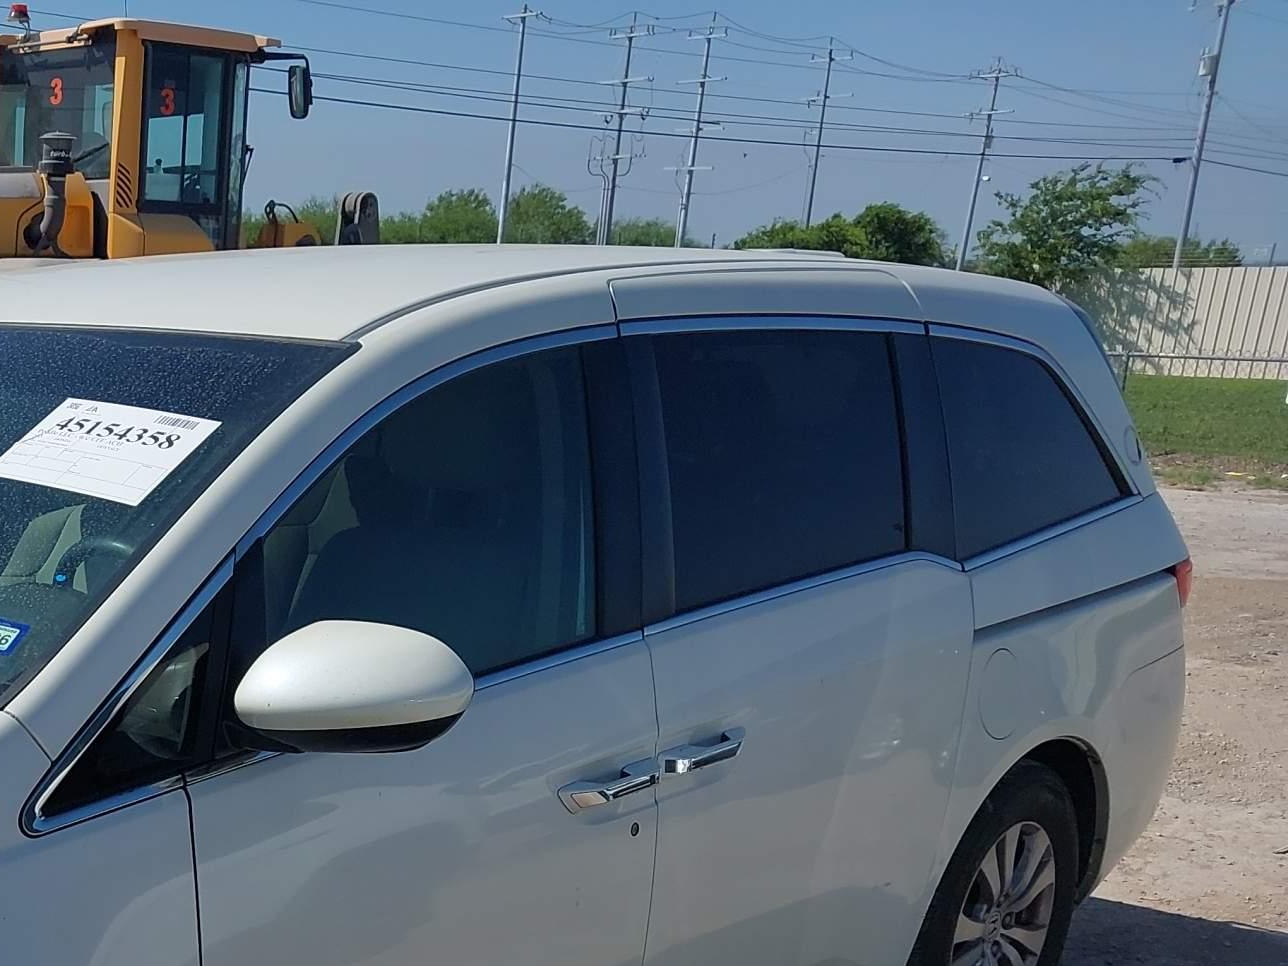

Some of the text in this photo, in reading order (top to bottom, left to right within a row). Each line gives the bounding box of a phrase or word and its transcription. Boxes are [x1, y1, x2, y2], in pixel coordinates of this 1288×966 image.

[49, 77, 63, 105] 3
[159, 88, 175, 115] 3
[55, 416, 181, 450] 45154358
